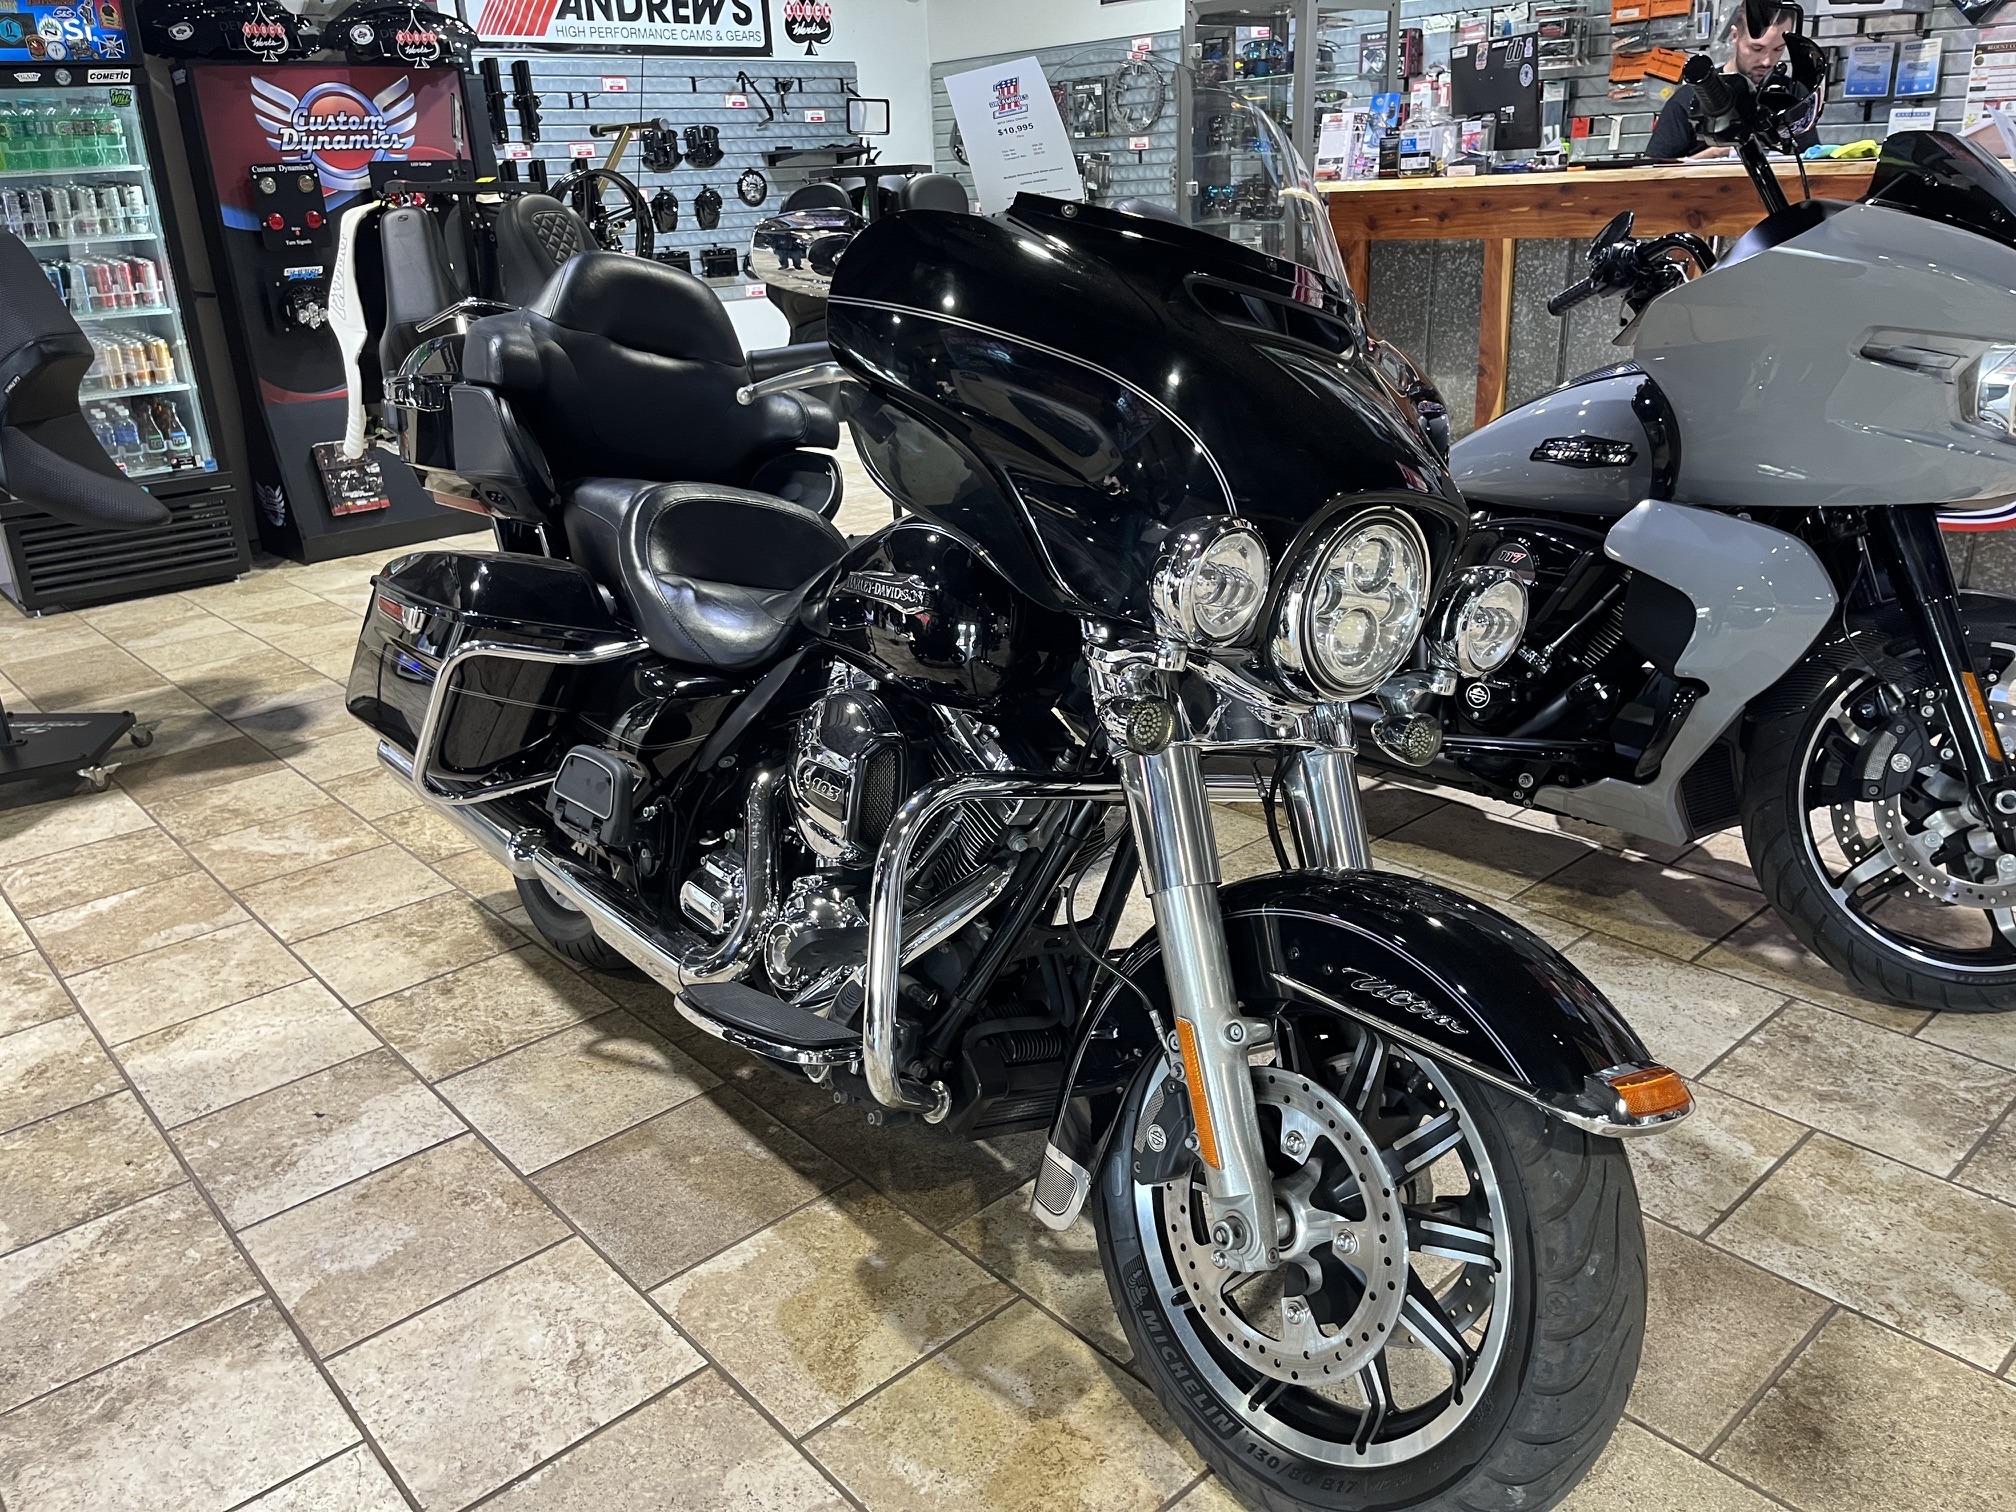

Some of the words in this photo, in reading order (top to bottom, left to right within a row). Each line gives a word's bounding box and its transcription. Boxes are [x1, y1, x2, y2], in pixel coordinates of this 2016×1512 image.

[555, 0, 753, 26] ANDREWS
[555, 26, 586, 38] HIGH
[589, 27, 678, 40] PERFORMANCE
[681, 29, 713, 41] CAMS
[716, 31, 723, 41] &
[725, 30, 762, 42] GEARS
[292, 107, 387, 131] Custom
[997, 122, 1034, 137] $10,995
[280, 129, 406, 160] Dynamics
[251, 165, 276, 173] Custom
[1498, 550, 1527, 564] 117
[846, 575, 926, 604] HARLEY-DAVIDSON
[811, 777, 842, 802] 103
[1142, 1309, 1236, 1437] MICHELIN
[1248, 1442, 1313, 1487] 130/80
[1320, 1476, 1358, 1494] B17
